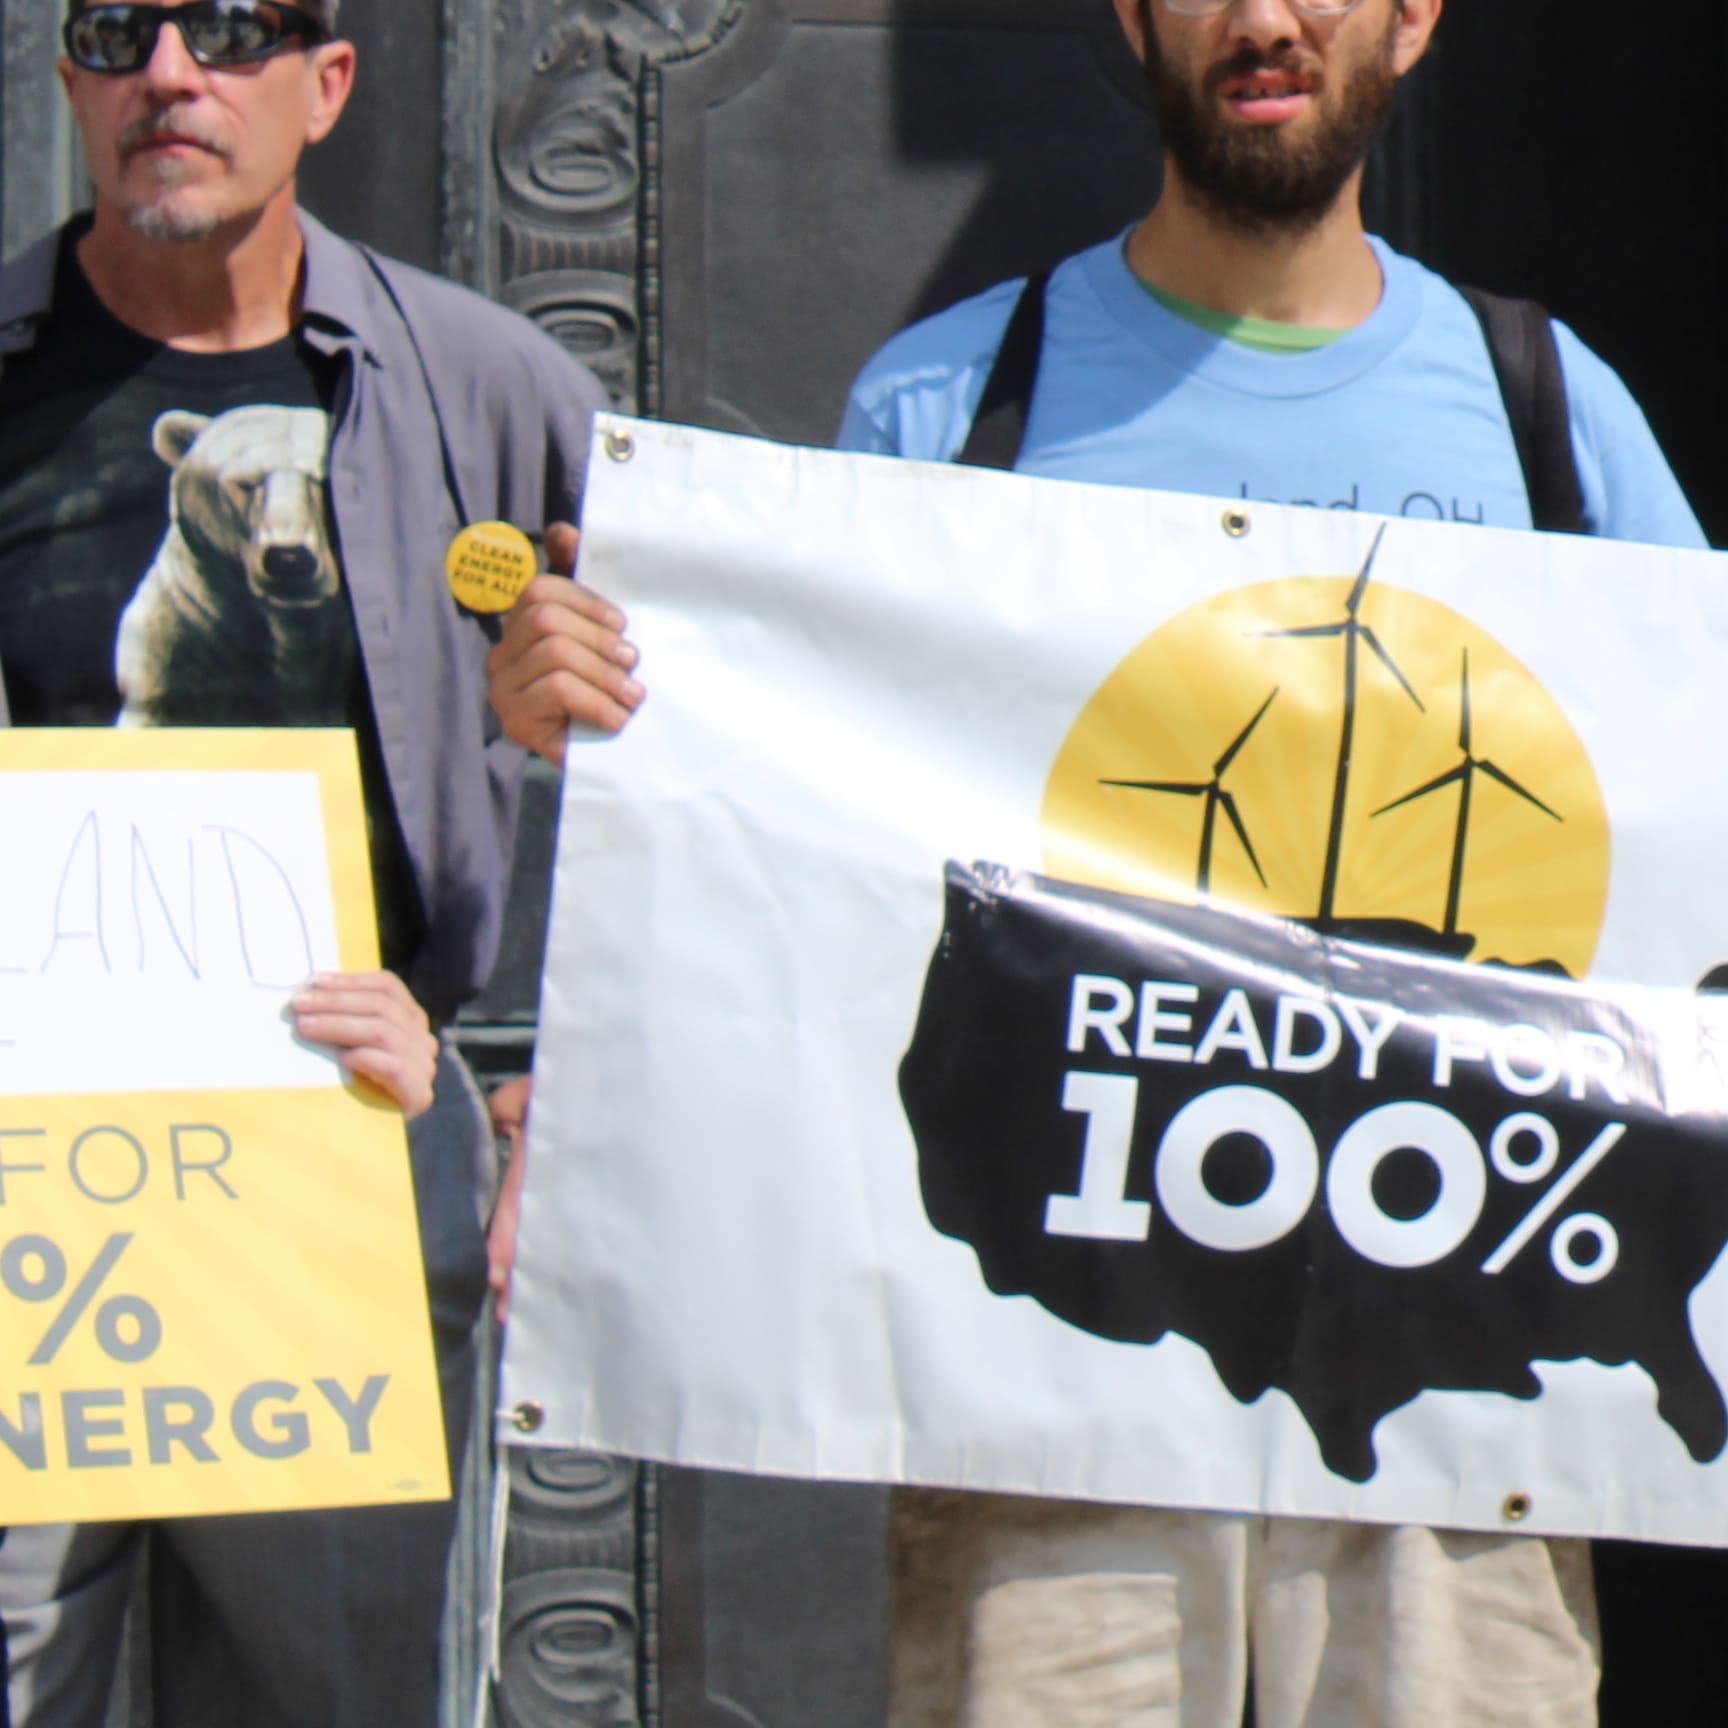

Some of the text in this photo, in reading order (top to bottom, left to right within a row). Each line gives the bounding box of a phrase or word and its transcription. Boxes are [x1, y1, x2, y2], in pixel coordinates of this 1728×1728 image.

[458, 554, 524, 581] ENERGY
[1066, 972, 1630, 1106] READY FOR
[1044, 1070, 1628, 1285] 100%
